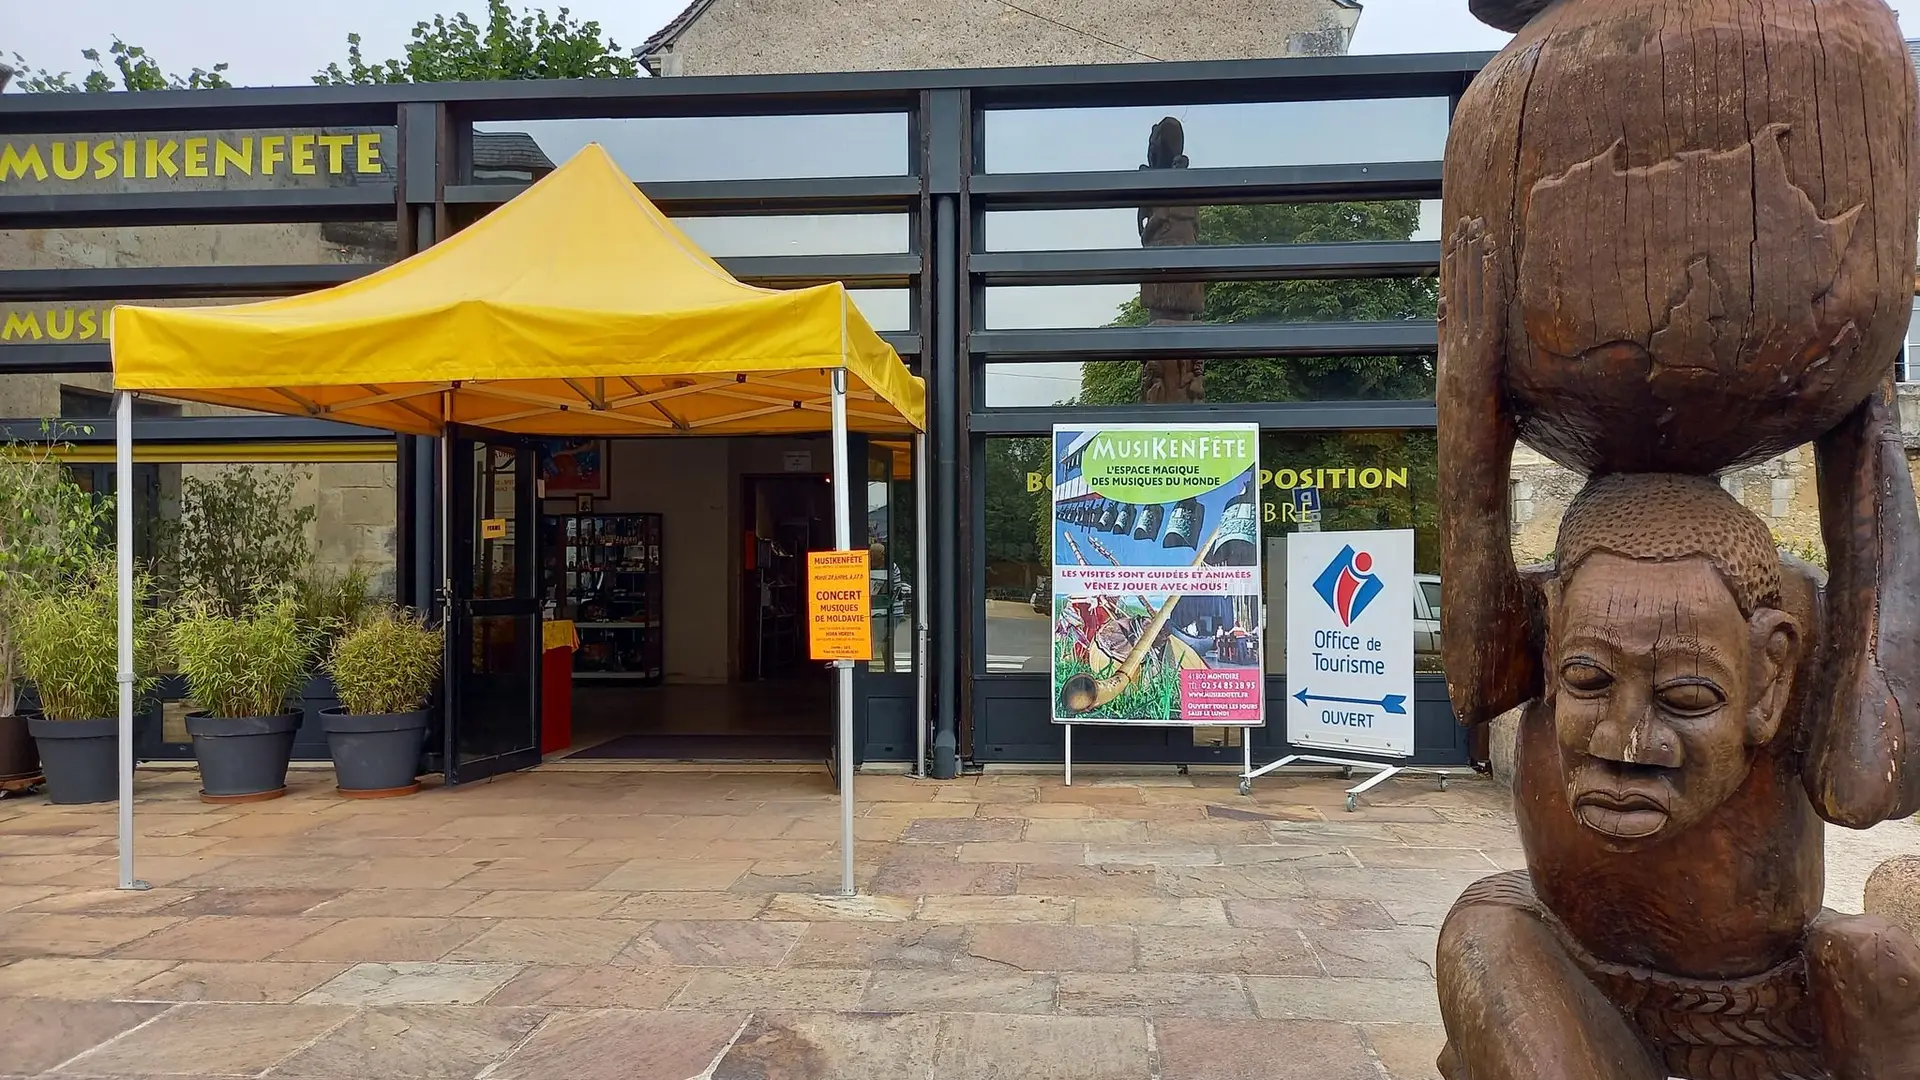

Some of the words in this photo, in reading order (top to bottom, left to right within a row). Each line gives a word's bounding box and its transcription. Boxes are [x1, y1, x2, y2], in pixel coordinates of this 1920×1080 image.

[0, 134, 382, 181] MUSIKENFETE
[1106, 465, 1150, 475] L'ESPACE
[1152, 465, 1200, 476] MAGIQUE
[1091, 477, 1110, 486] DES
[1112, 477, 1163, 488] MUSIQUES
[1166, 477, 1181, 486] DU
[1183, 477, 1220, 486] MONDE
[1062, 570, 1077, 578] LES
[1081, 570, 1116, 579] VISITES
[1118, 571, 1145, 579] SONT
[1147, 569, 1189, 579] GUIDÉES
[1205, 569, 1252, 579] ANIMÉES
[1084, 582, 1120, 591] VENEZ
[1122, 582, 1158, 591] JOUER
[1160, 582, 1189, 591] AVEC
[1191, 582, 1221, 591] NOUS
[816, 590, 862, 600] CONCERT
[820, 604, 858, 613] MUSIQUES
[826, 614, 864, 622] MOLDAVIE
[1314, 630, 1360, 650] Office
[1366, 637, 1382, 651] de
[1312, 652, 1385, 675] Tourisme
[1201, 681, 1211, 689] 02
[1213, 681, 1222, 689] 54
[1223, 681, 1233, 689] 85
[1321, 710, 1374, 728] OUVERT
